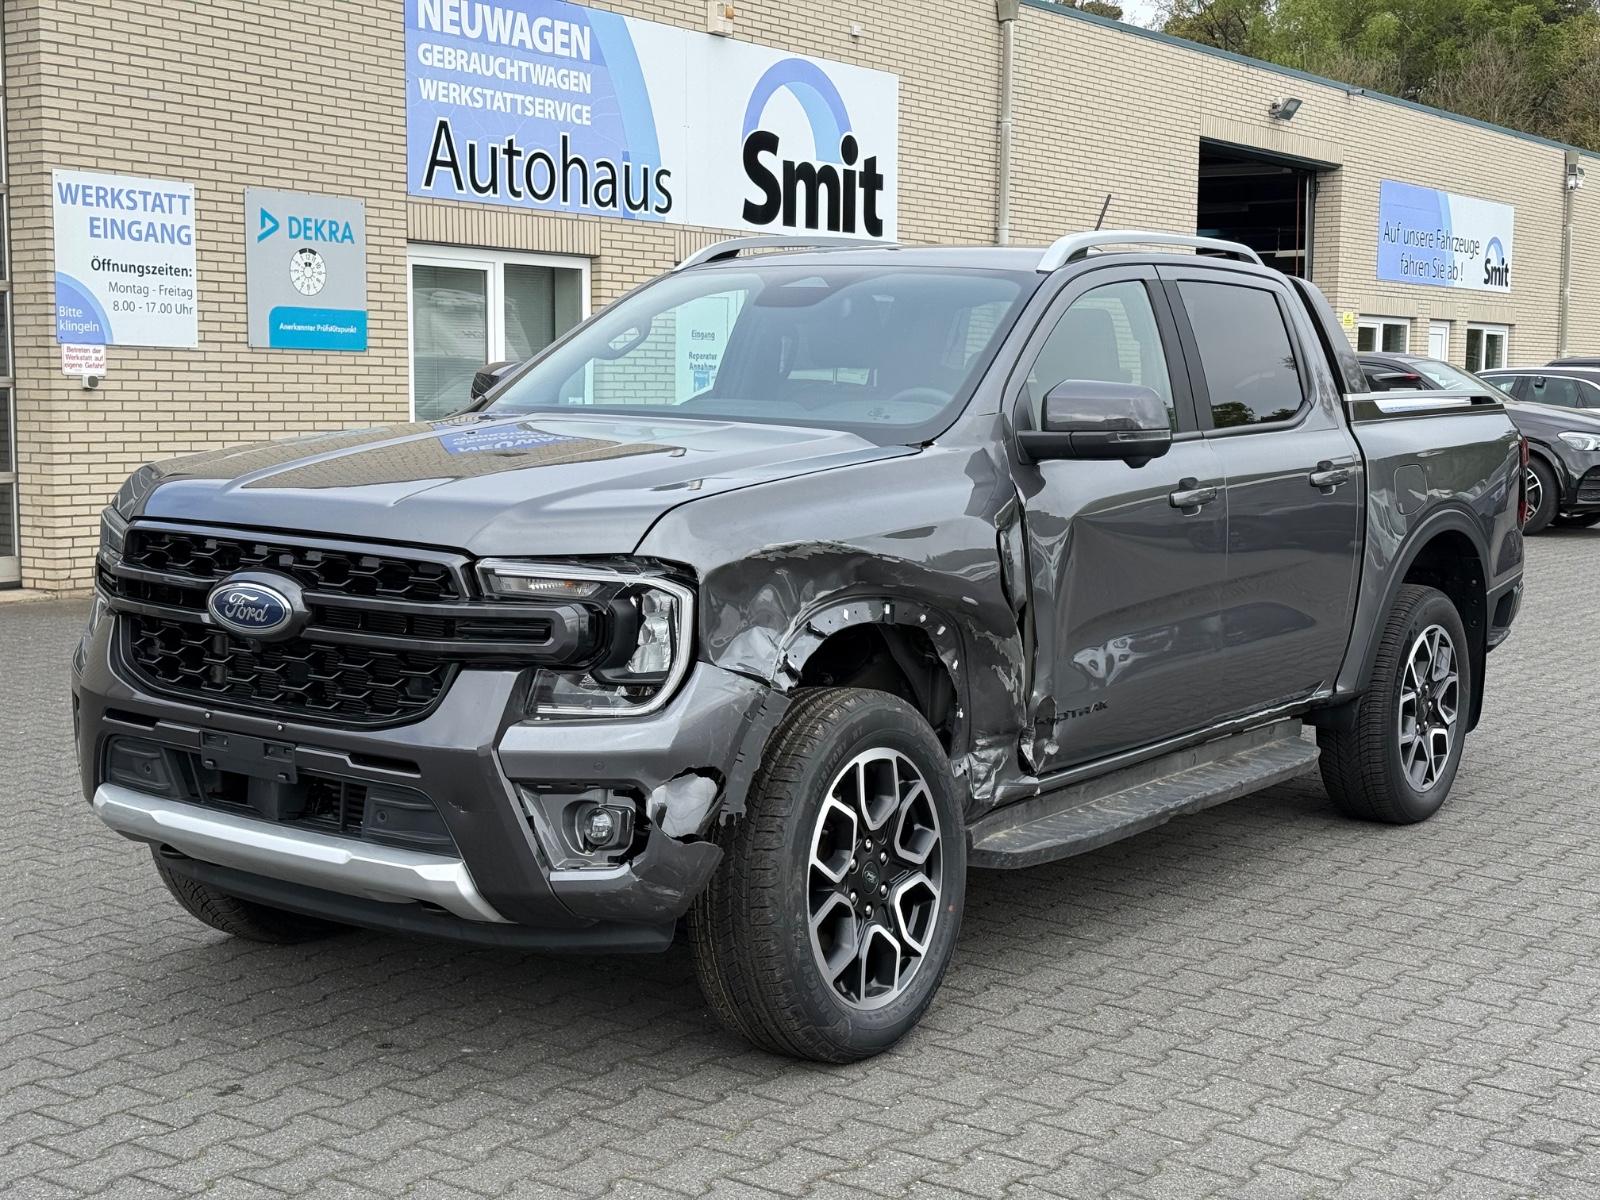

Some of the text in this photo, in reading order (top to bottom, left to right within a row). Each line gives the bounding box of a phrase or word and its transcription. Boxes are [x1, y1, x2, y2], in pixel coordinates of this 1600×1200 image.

[417, 0, 591, 61] NEUWAGEN
[417, 43, 592, 94] GEBRAUCHTWAGEN
[418, 77, 592, 126] WERKSTATTSERVICE
[423, 118, 673, 215] Autohaus
[57, 182, 191, 216] WERKSTATT
[741, 130, 884, 238] Smit
[89, 216, 192, 246] EINGANG
[287, 215, 355, 244] DEKRA
[1383, 221, 1480, 260] Auf unsere Fahrzeuge
[91, 255, 193, 278] Öffnungszeiten:
[1400, 252, 1430, 277] fahren
[1432, 257, 1445, 279] Sie
[1447, 261, 1459, 281] ab
[1483, 256, 1509, 287] Smit
[108, 281, 150, 298] Montag
[159, 284, 193, 300] Freitag
[59, 306, 83, 317] Bitte
[113, 300, 136, 313] 8.00
[146, 302, 173, 315] 17.00
[175, 303, 194, 316] Uhr
[60, 320, 99, 333] klingeln
[692, 330, 715, 341] Eingang
[66, 346, 91, 354] Betreten
[224, 593, 270, 623] Ford
